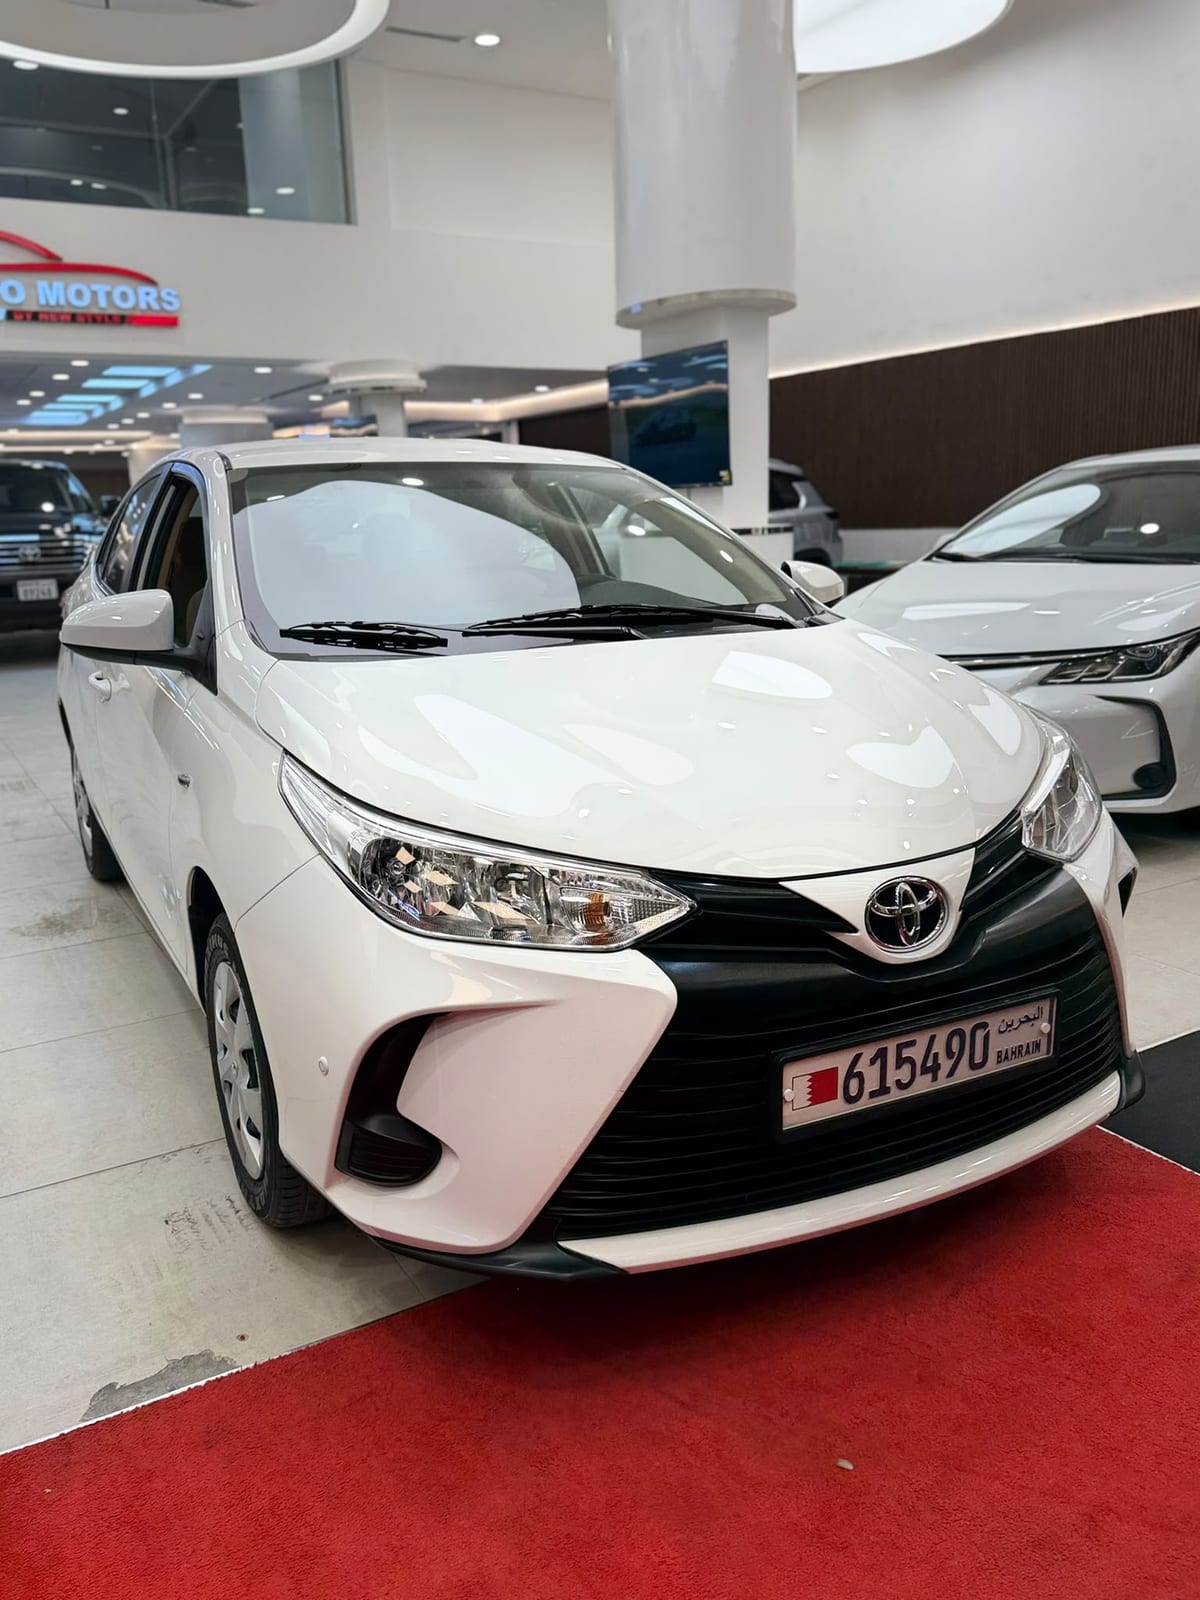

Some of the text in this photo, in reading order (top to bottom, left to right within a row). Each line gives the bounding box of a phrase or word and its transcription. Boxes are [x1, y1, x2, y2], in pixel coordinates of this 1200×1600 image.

[37, 280, 181, 311] MOTORS
[38, 312, 72, 323] NEW
[76, 314, 122, 324] STYLE
[998, 1006, 1044, 1034] البحرين
[842, 1021, 990, 1105] 615490
[996, 1039, 1042, 1065] BAHRAIN
